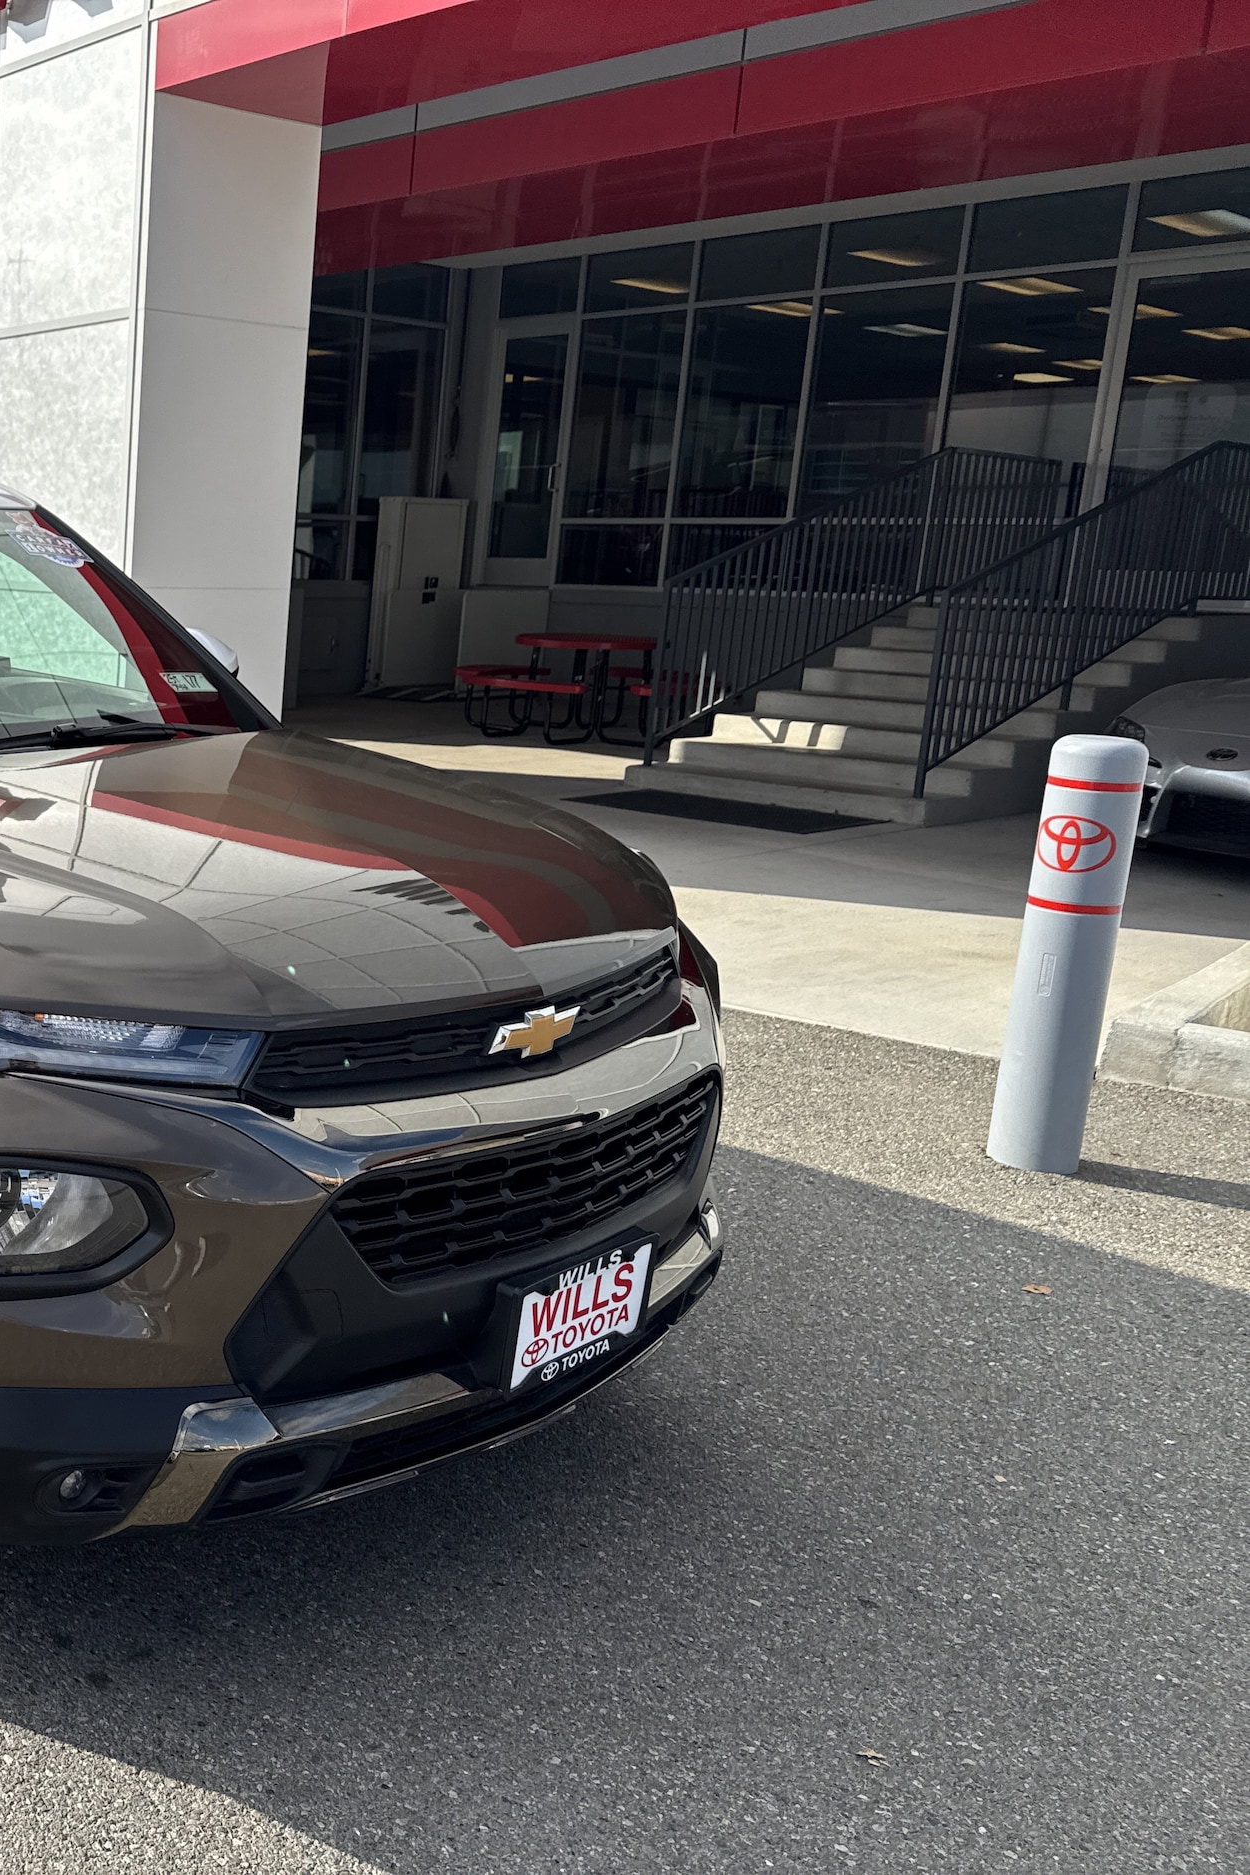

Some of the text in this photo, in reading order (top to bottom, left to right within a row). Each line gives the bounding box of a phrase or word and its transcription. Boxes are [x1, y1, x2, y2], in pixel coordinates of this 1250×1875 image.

[558, 1249, 623, 1289] WILLS
[532, 1263, 635, 1338] WILLS
[551, 1303, 629, 1354] TOYOTA
[562, 1338, 611, 1371] TOYOTA
